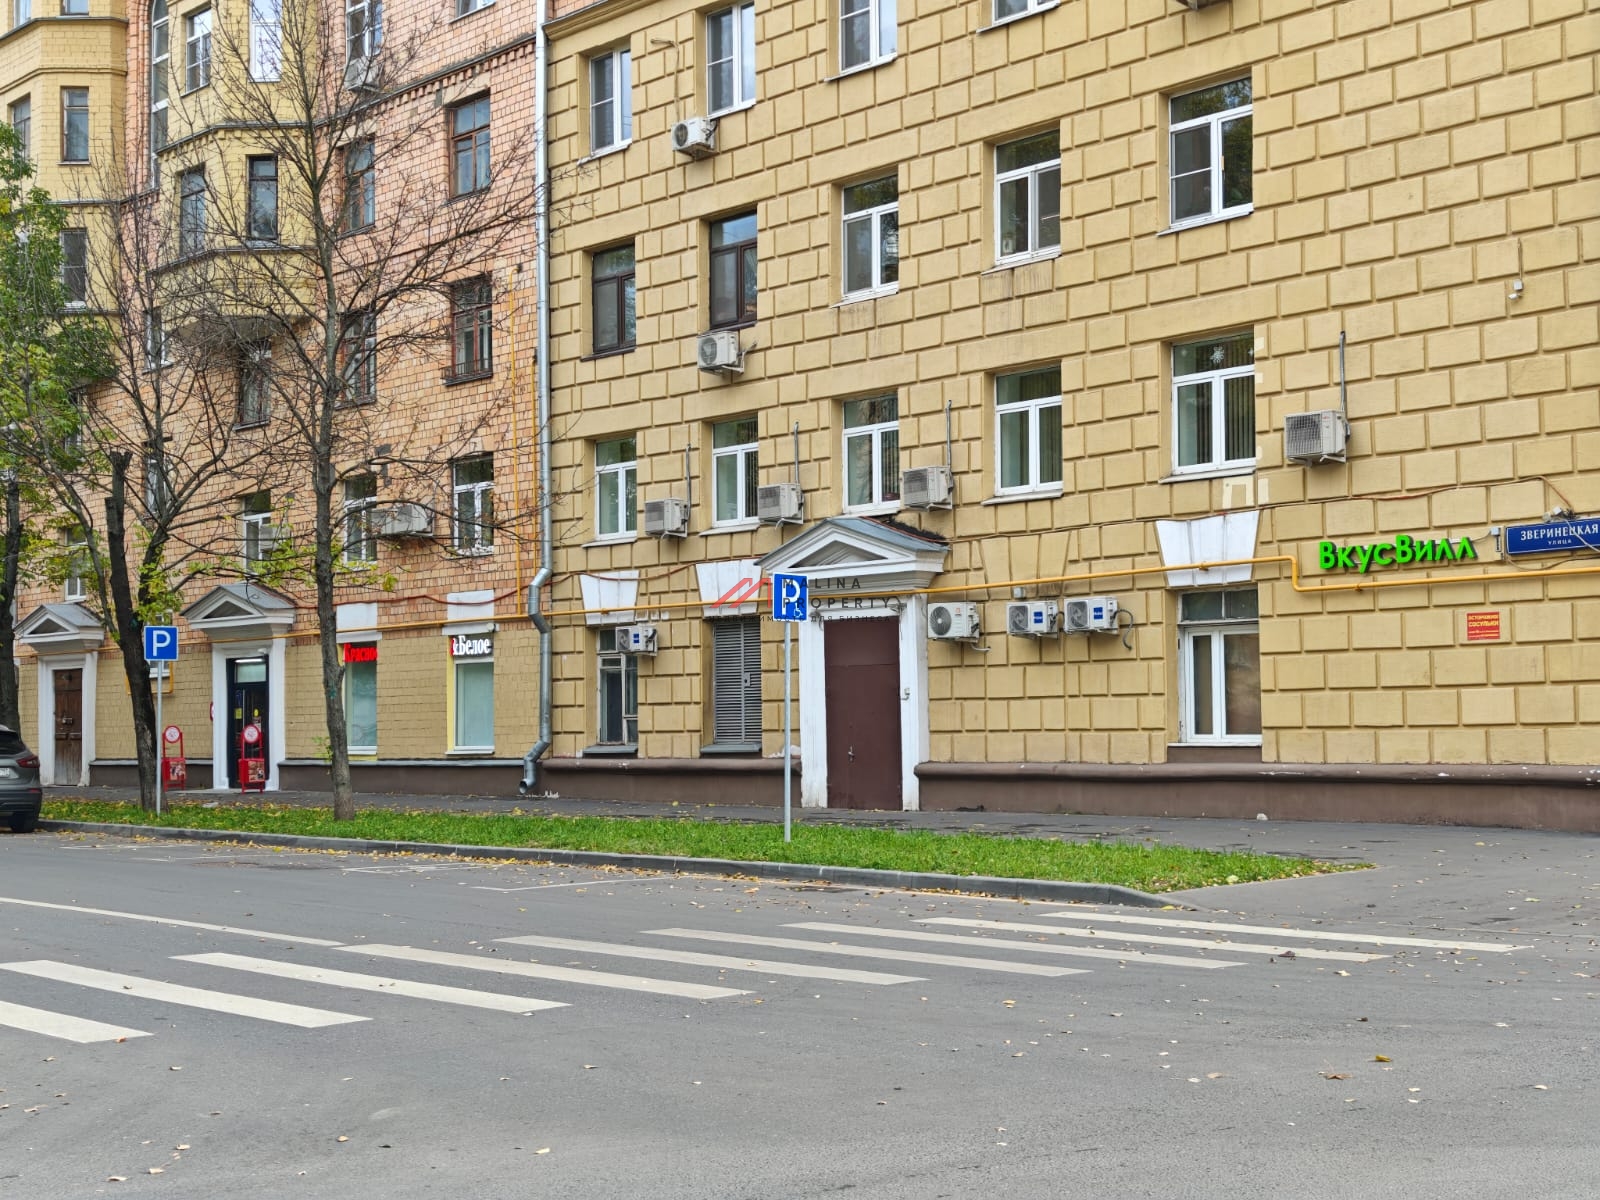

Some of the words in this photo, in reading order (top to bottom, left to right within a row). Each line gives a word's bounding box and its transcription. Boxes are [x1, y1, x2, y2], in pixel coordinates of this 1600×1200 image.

[1520, 523, 1599, 541] ЗВЕРИНЕЦКАЯ
[1319, 534, 1476, 574] ВкусВилл
[152, 630, 171, 656] P
